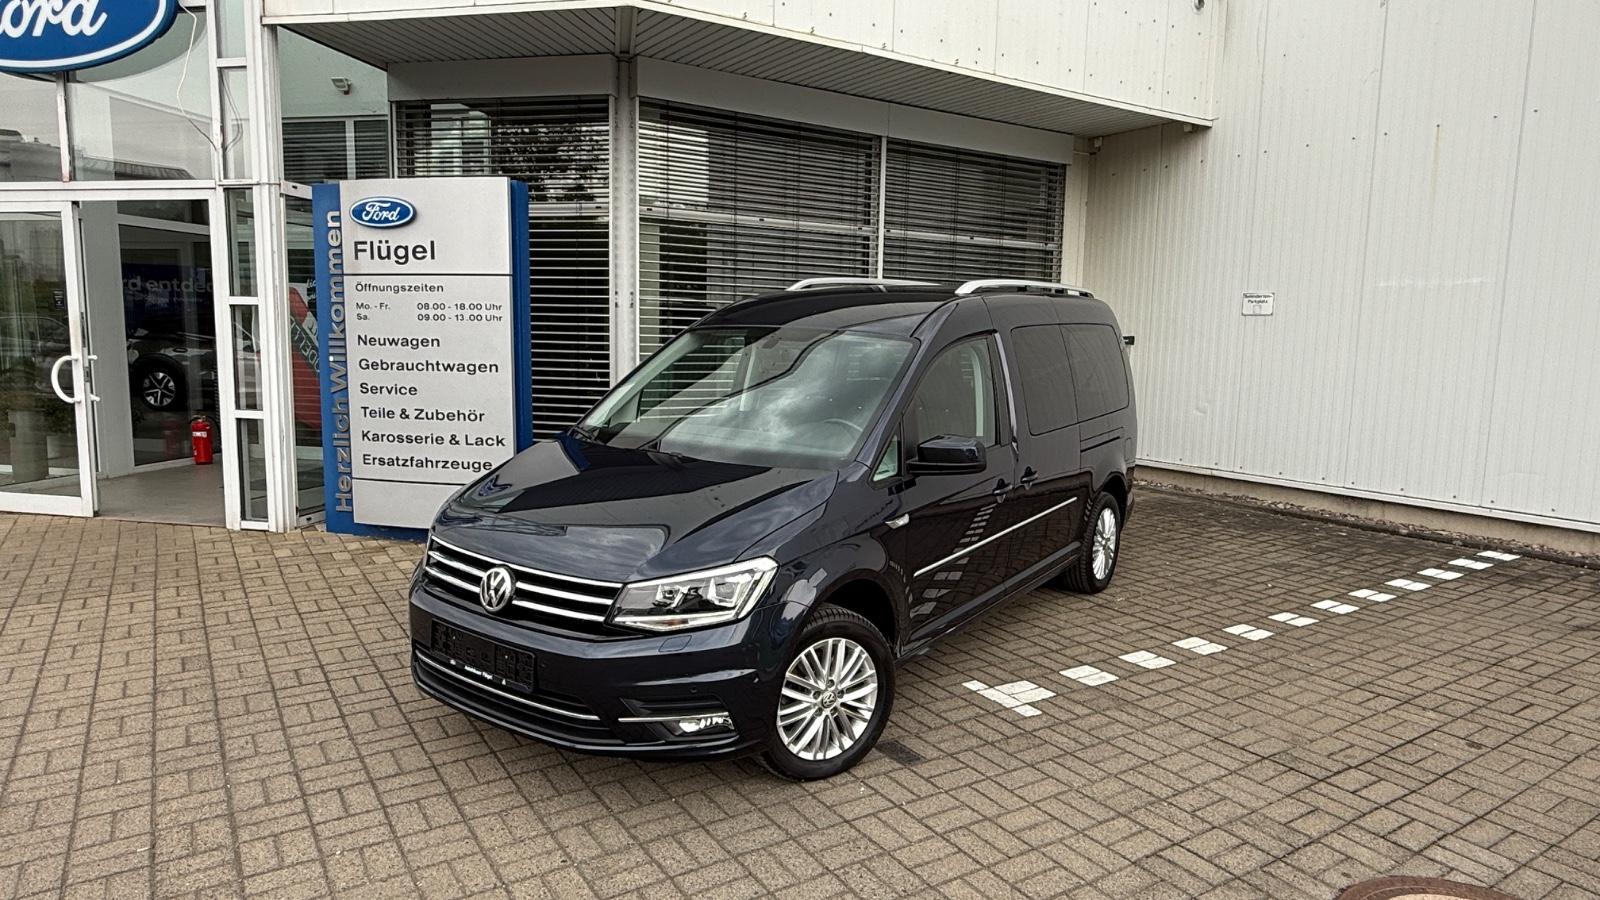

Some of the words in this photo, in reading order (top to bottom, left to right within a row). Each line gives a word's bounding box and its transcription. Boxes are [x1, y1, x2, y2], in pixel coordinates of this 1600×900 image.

[0, 0, 107, 37] ord
[362, 202, 400, 221] Ford
[354, 240, 436, 265] Flügel
[355, 282, 444, 294] Öffnungszeiten
[327, 211, 347, 393] Willkommen
[417, 303, 446, 311] 08.00
[455, 303, 483, 311] 18.00
[485, 303, 503, 311] Uhr
[357, 313, 370, 321] Sa.
[417, 314, 447, 322] 09.00
[455, 314, 483, 322] 13.00
[357, 334, 440, 350] Neuwagen
[359, 358, 499, 375] Gebrauchtwagen
[360, 383, 418, 395] Service
[361, 407, 395, 419] Teile
[400, 408, 410, 420] &
[414, 408, 485, 422] Zubehör
[361, 430, 445, 445] Karosserie
[449, 434, 460, 445] &
[465, 434, 506, 447] Lack
[332, 399, 352, 512] Herzlich
[362, 454, 493, 473] Ersatzfahrzeuge
